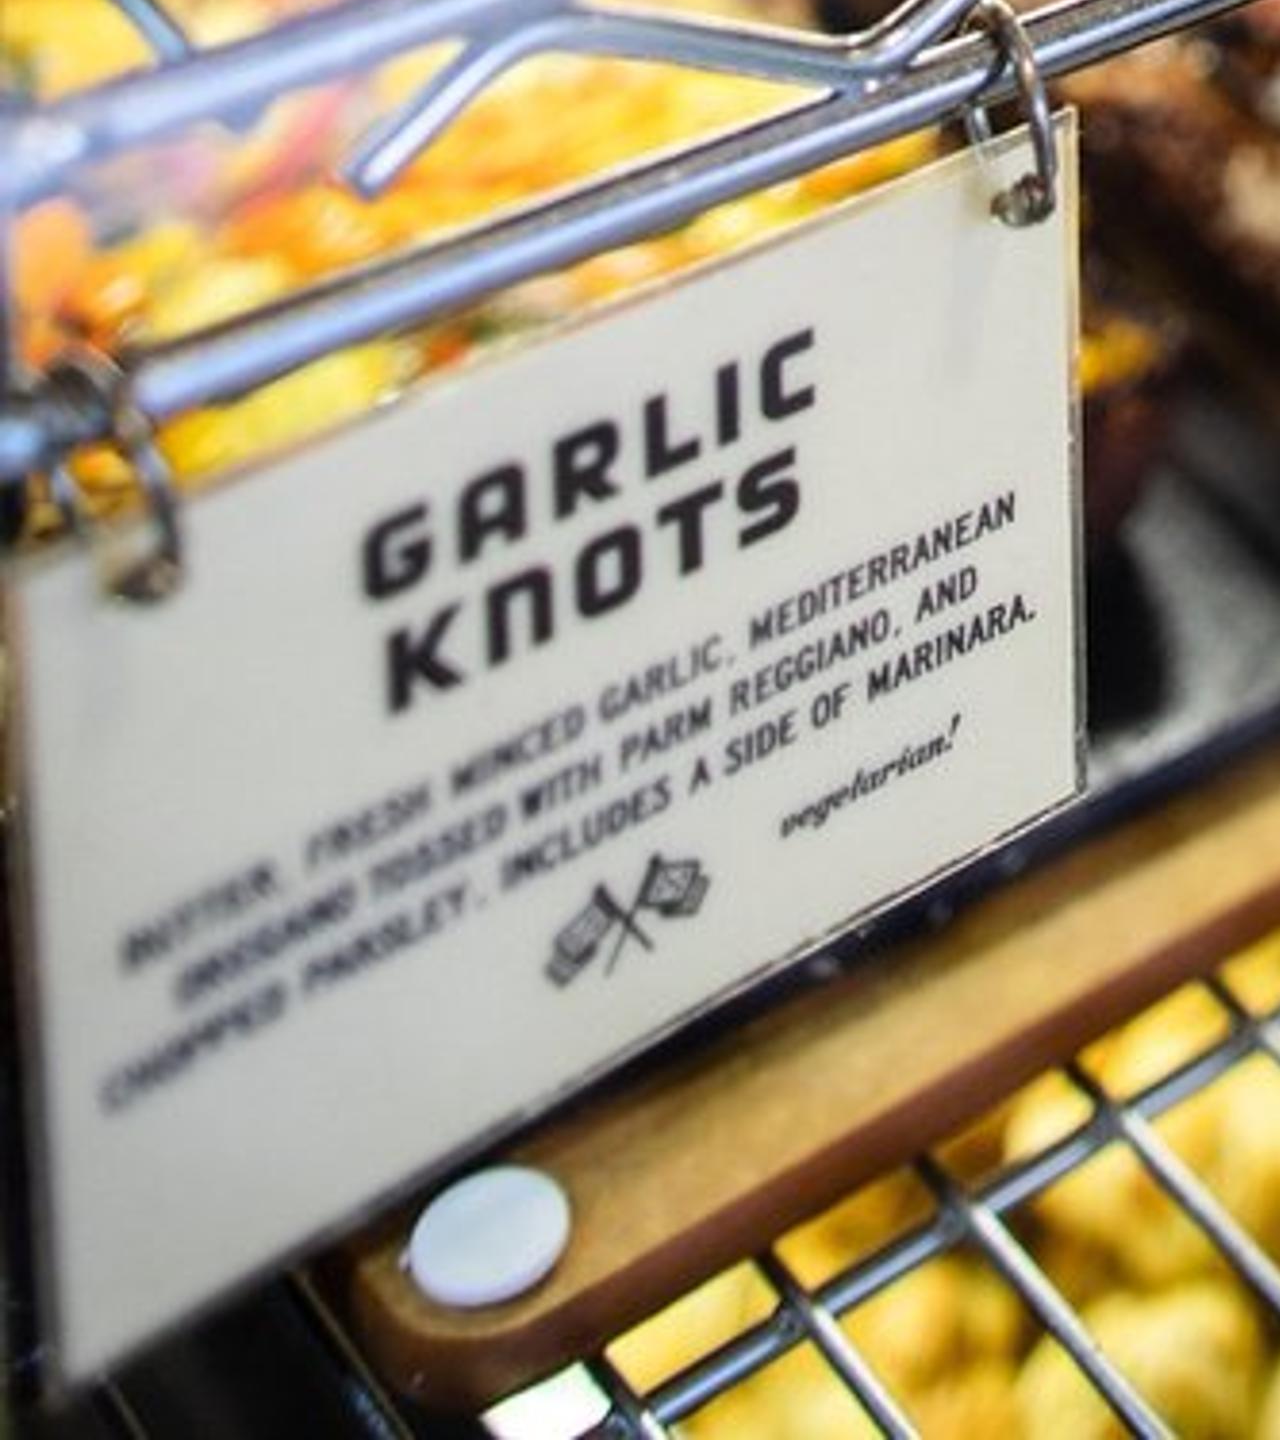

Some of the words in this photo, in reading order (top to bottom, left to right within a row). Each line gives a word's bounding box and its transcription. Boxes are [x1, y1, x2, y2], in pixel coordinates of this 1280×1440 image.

[356, 324, 821, 607] GARLIC
[380, 444, 804, 722] KNOTS
[748, 490, 1017, 650] MEDITERRANEAN
[500, 773, 673, 892] INCLUDES
[688, 755, 712, 797] A
[722, 709, 798, 777] SIDE
[810, 682, 852, 730] OF
[866, 593, 1038, 703] MARINARA.
[519, 753, 604, 820] WITH
[618, 694, 713, 773] PARM
[729, 608, 903, 716] REGGIANO,
[915, 565, 979, 624] AND
[780, 712, 962, 839] vegetarian!
